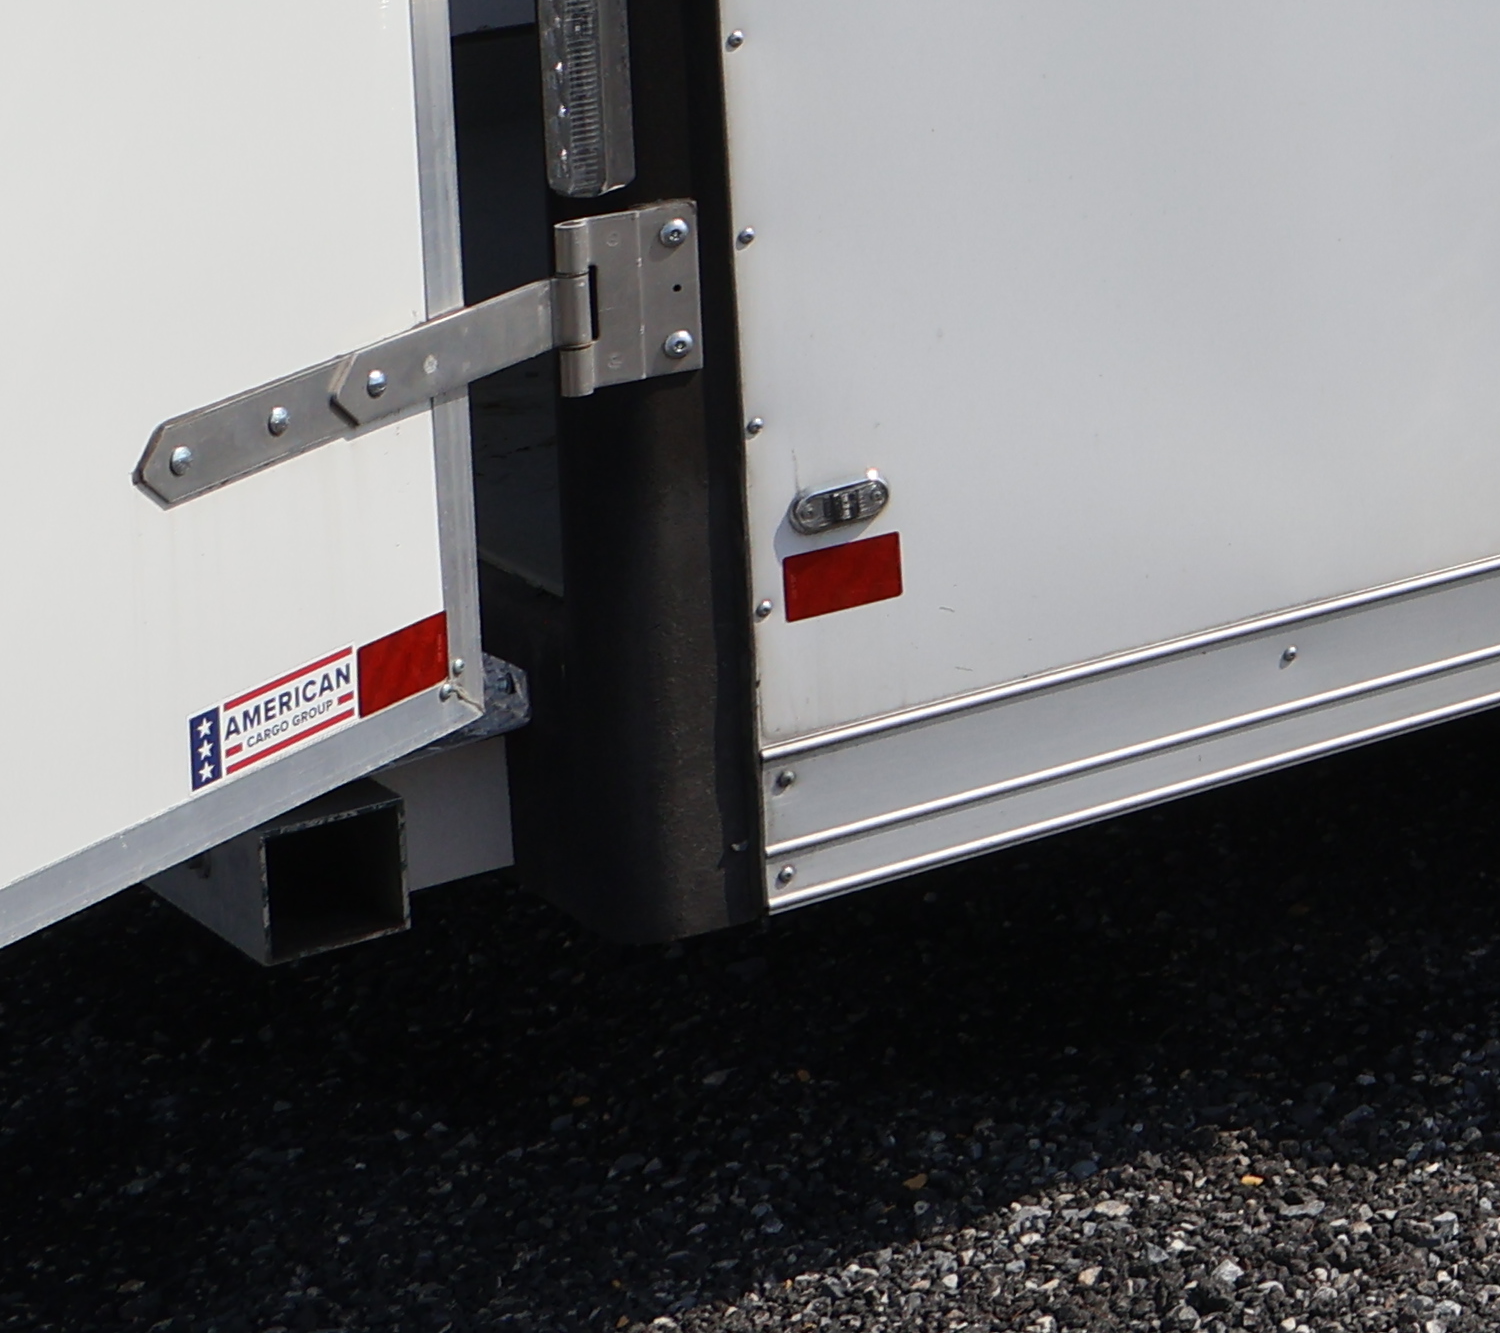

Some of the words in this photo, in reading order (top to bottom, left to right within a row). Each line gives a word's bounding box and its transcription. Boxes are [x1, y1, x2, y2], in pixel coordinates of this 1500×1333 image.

[224, 662, 352, 741] AMERICAN
[246, 719, 290, 749] CARGO
[291, 699, 334, 728] GROUP
